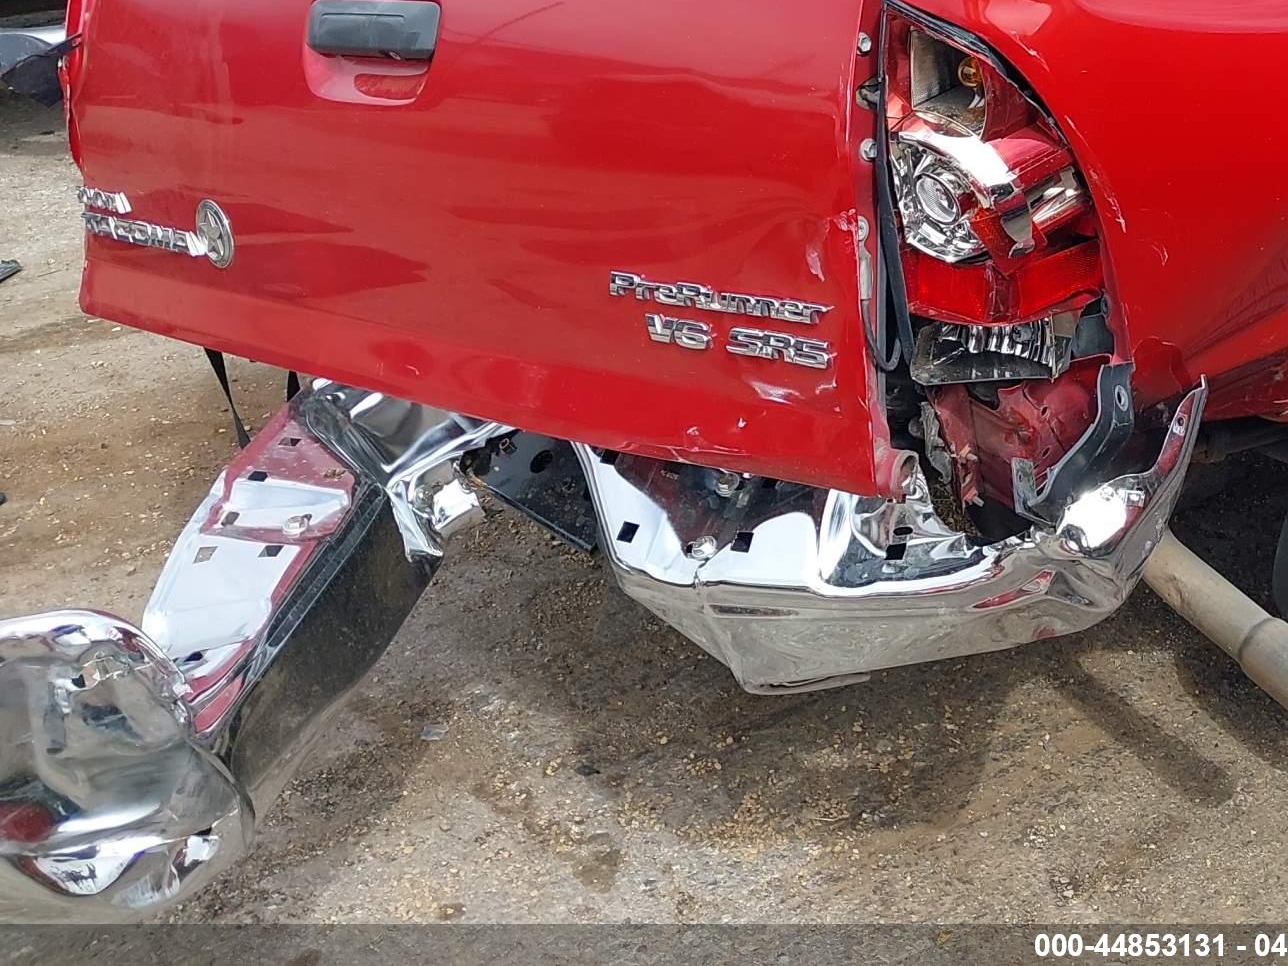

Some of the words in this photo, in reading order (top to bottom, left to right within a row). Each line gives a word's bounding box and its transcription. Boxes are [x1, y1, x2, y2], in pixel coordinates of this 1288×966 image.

[81, 212, 208, 257] TACOMA
[609, 270, 831, 325] PreRunner
[644, 313, 714, 350] V6
[725, 327, 830, 370] SR5
